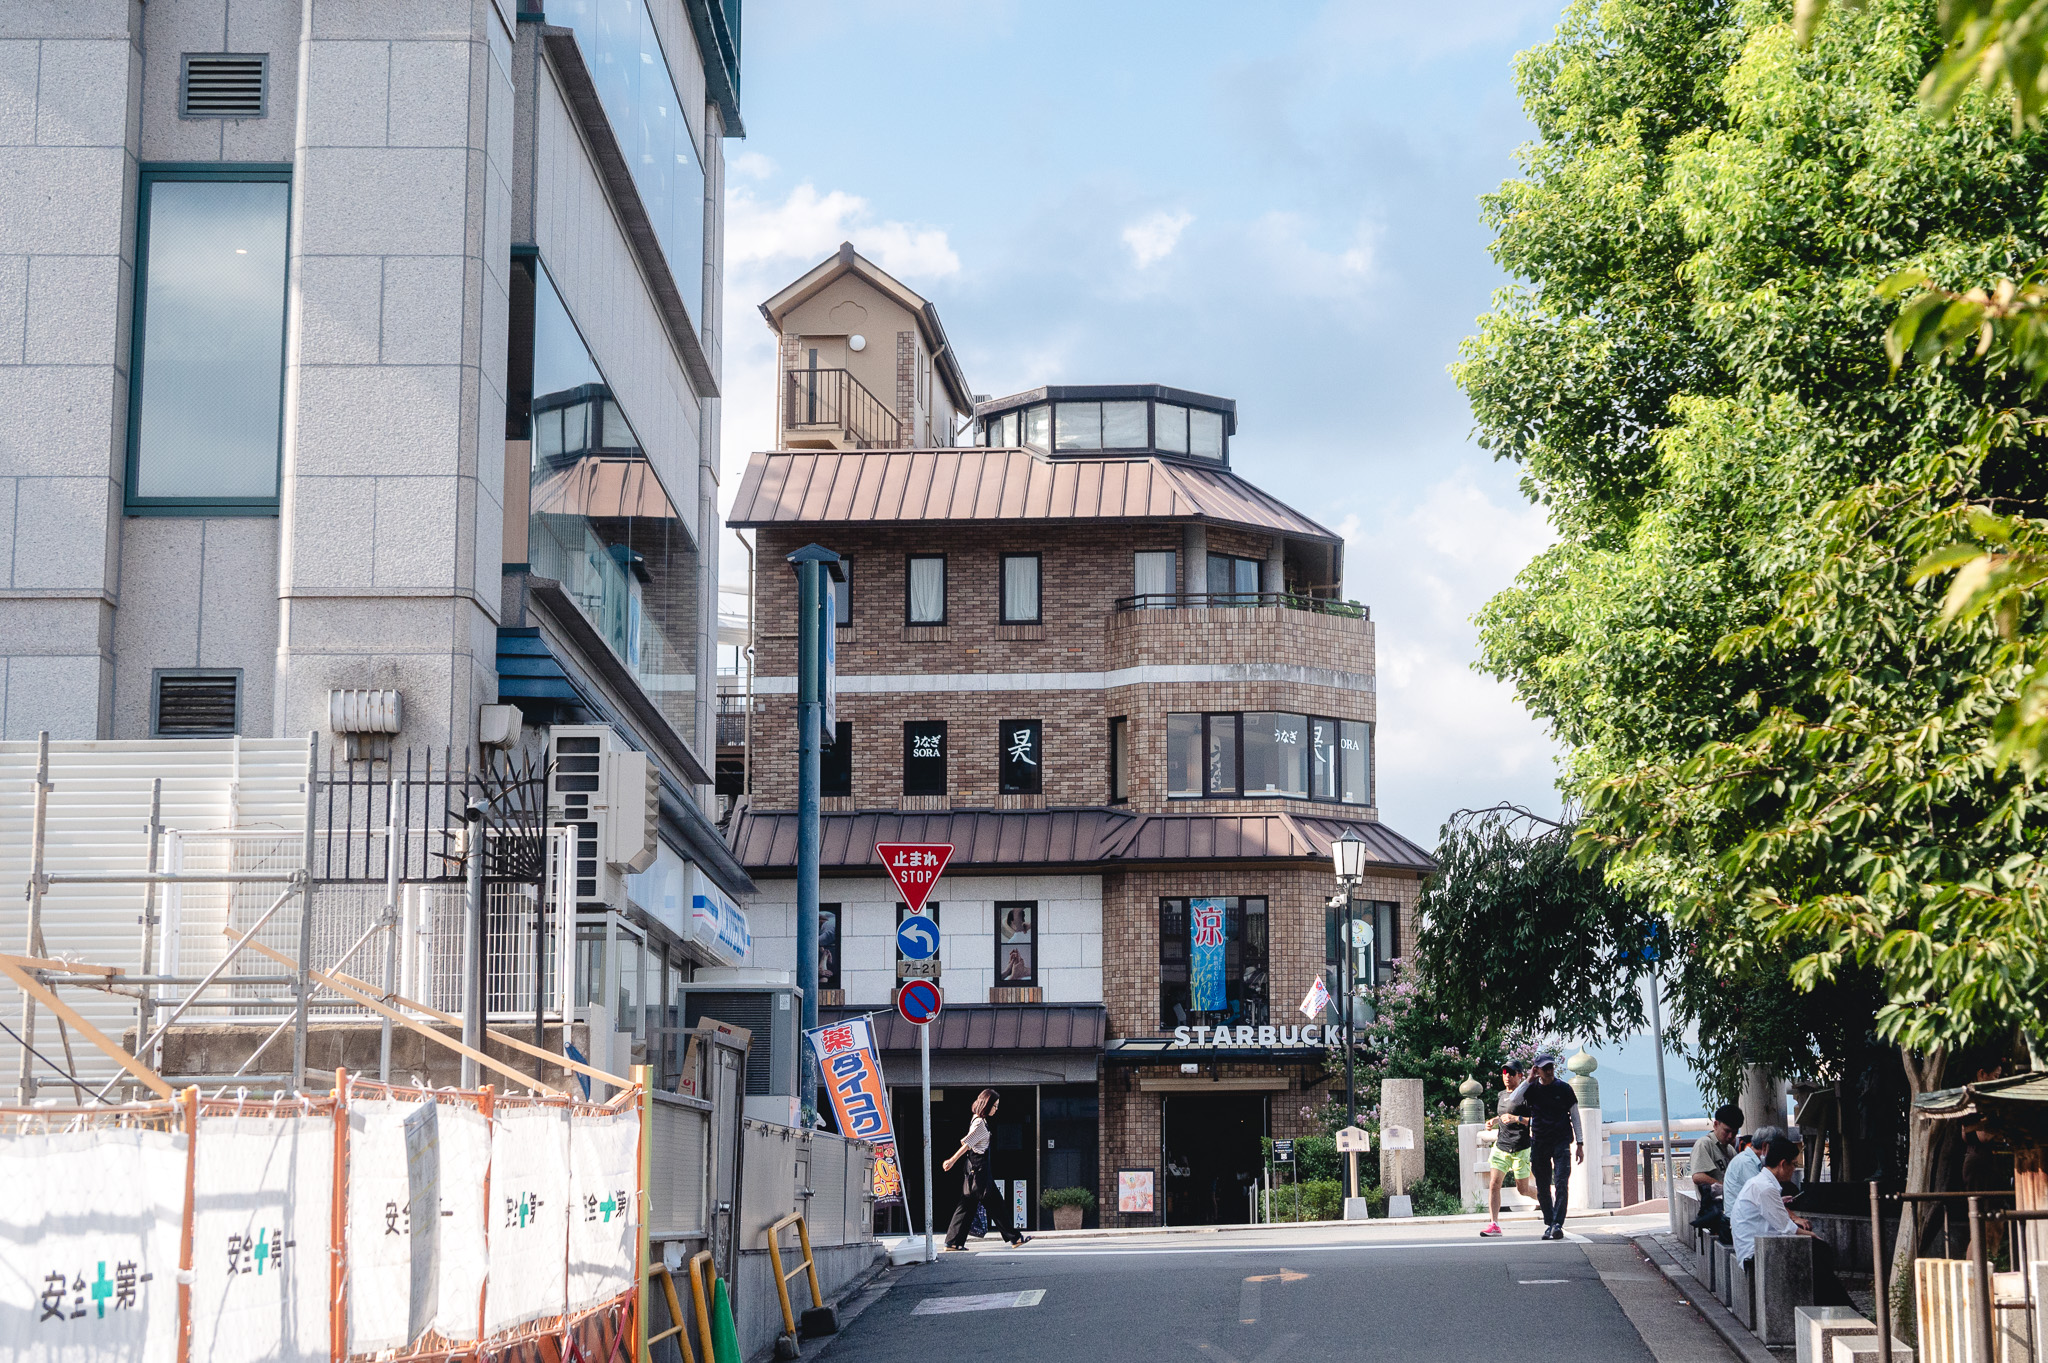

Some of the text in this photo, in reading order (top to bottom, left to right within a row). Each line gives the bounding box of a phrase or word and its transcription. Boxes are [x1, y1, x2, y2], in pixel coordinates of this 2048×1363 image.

[913, 734, 942, 748] うなぎ
[913, 748, 941, 757] SORA
[1007, 729, 1037, 766] 昊
[1274, 729, 1298, 744] うなぎ
[1340, 738, 1359, 750] ORA
[893, 851, 938, 867] 止まれ
[901, 870, 932, 883] STOP
[1194, 906, 1224, 946] 涼
[904, 963, 936, 974] 7-21
[821, 1025, 854, 1054] 薬
[832, 1051, 882, 1136] ダイコク
[1016, 1190, 1024, 1221] てもみん
[227, 1228, 296, 1275] 安全第一
[40, 1260, 153, 1322] 安全第一
